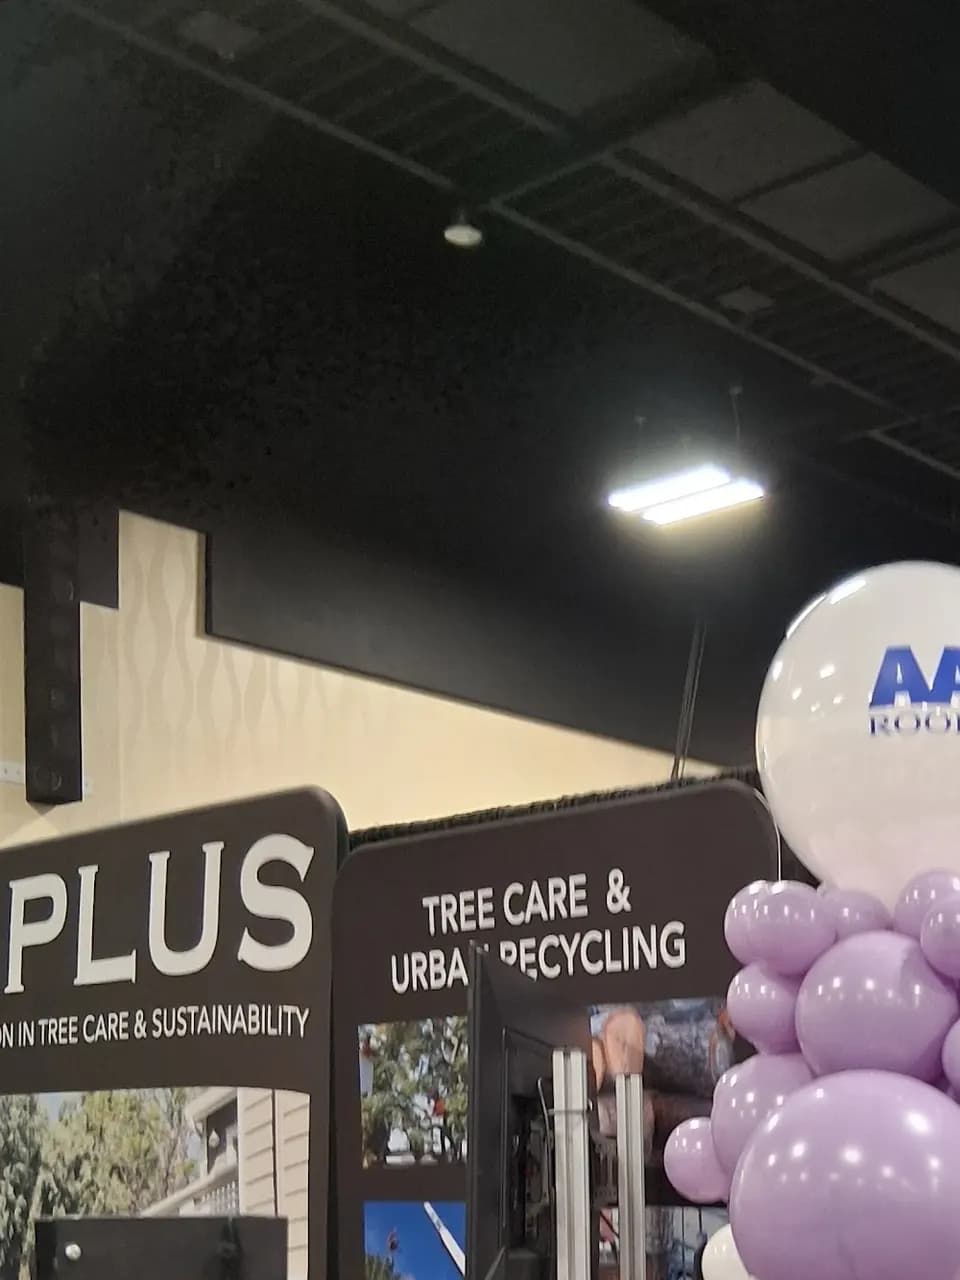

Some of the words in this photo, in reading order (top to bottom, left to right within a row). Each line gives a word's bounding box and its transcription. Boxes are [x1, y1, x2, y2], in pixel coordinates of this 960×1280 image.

[4, 833, 315, 995] PLUS
[422, 886, 495, 937] TREE
[503, 872, 589, 926] CARE
[606, 867, 632, 914] &
[391, 940, 489, 994] URBA
[18, 1019, 35, 1047] IN
[38, 1015, 79, 1046] TREE
[83, 1010, 129, 1043] CARE
[133, 1008, 148, 1039] &
[152, 1003, 310, 1039] SUSTAINABILITY
